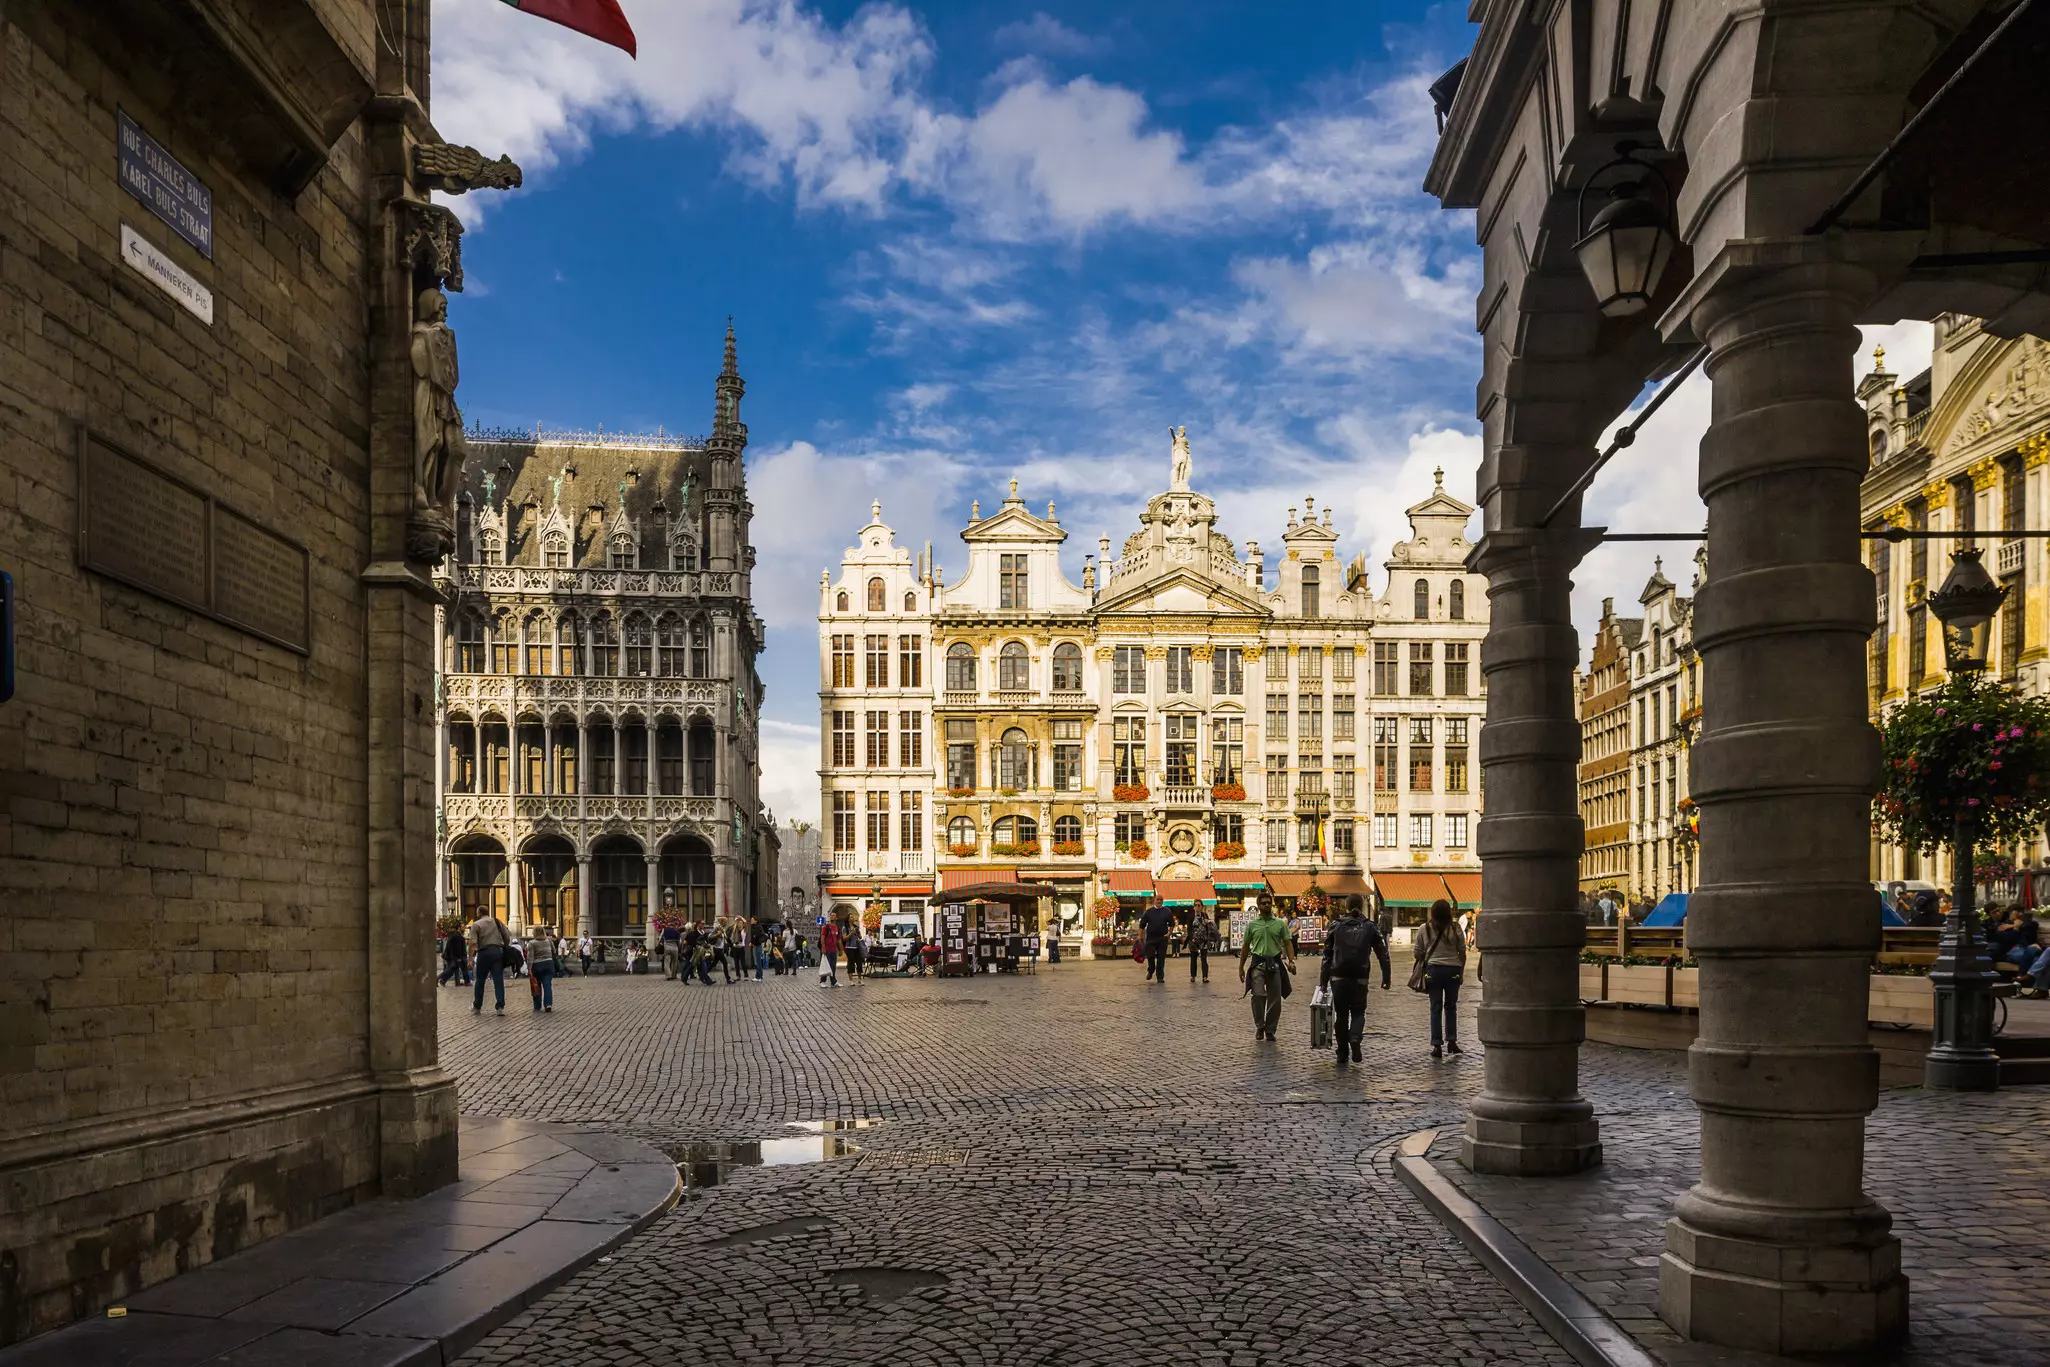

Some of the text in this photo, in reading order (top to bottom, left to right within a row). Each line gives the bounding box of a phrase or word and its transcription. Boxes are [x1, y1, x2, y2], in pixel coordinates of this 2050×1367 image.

[122, 156, 208, 245] KAREL BULS STRAAT
[123, 125, 208, 215] RUE CHARLES BULS
[147, 255, 209, 311] MANNEKEN PIS
